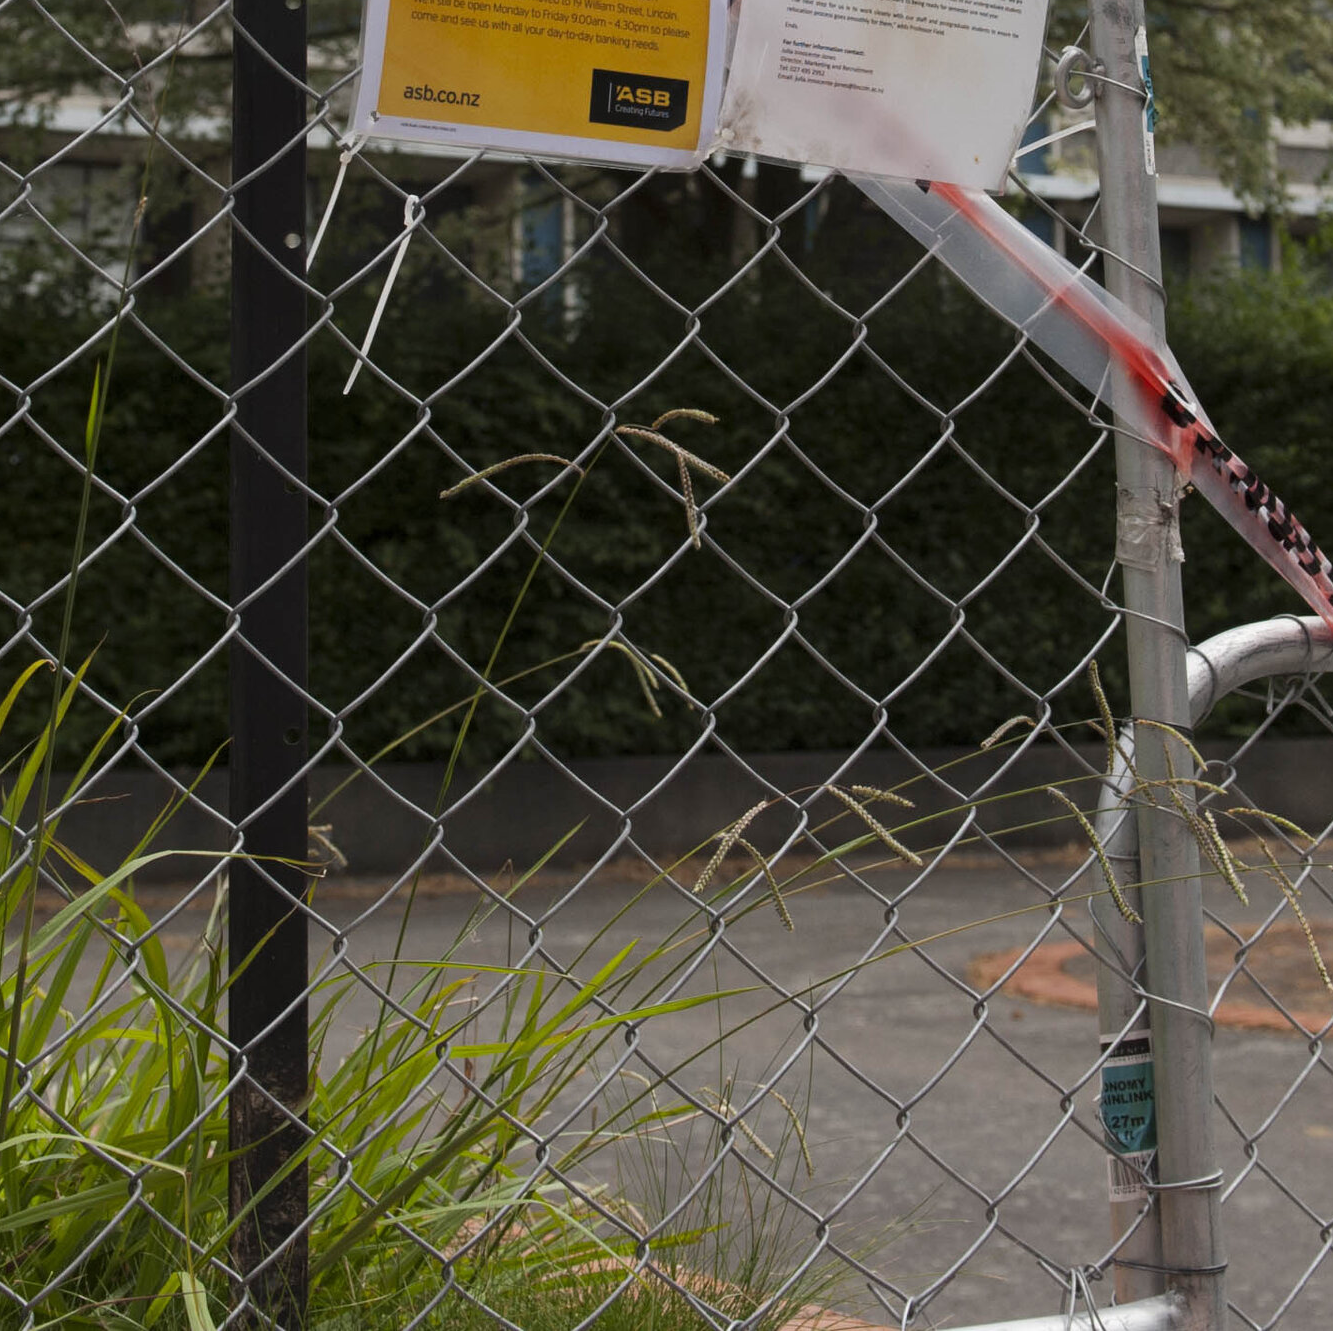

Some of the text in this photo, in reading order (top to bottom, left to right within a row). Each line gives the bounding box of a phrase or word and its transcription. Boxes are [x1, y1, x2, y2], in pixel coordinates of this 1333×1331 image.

[403, 84, 480, 107] asb.co.nz
[616, 85, 670, 107] ASB
[614, 103, 669, 118] Creating Futures
